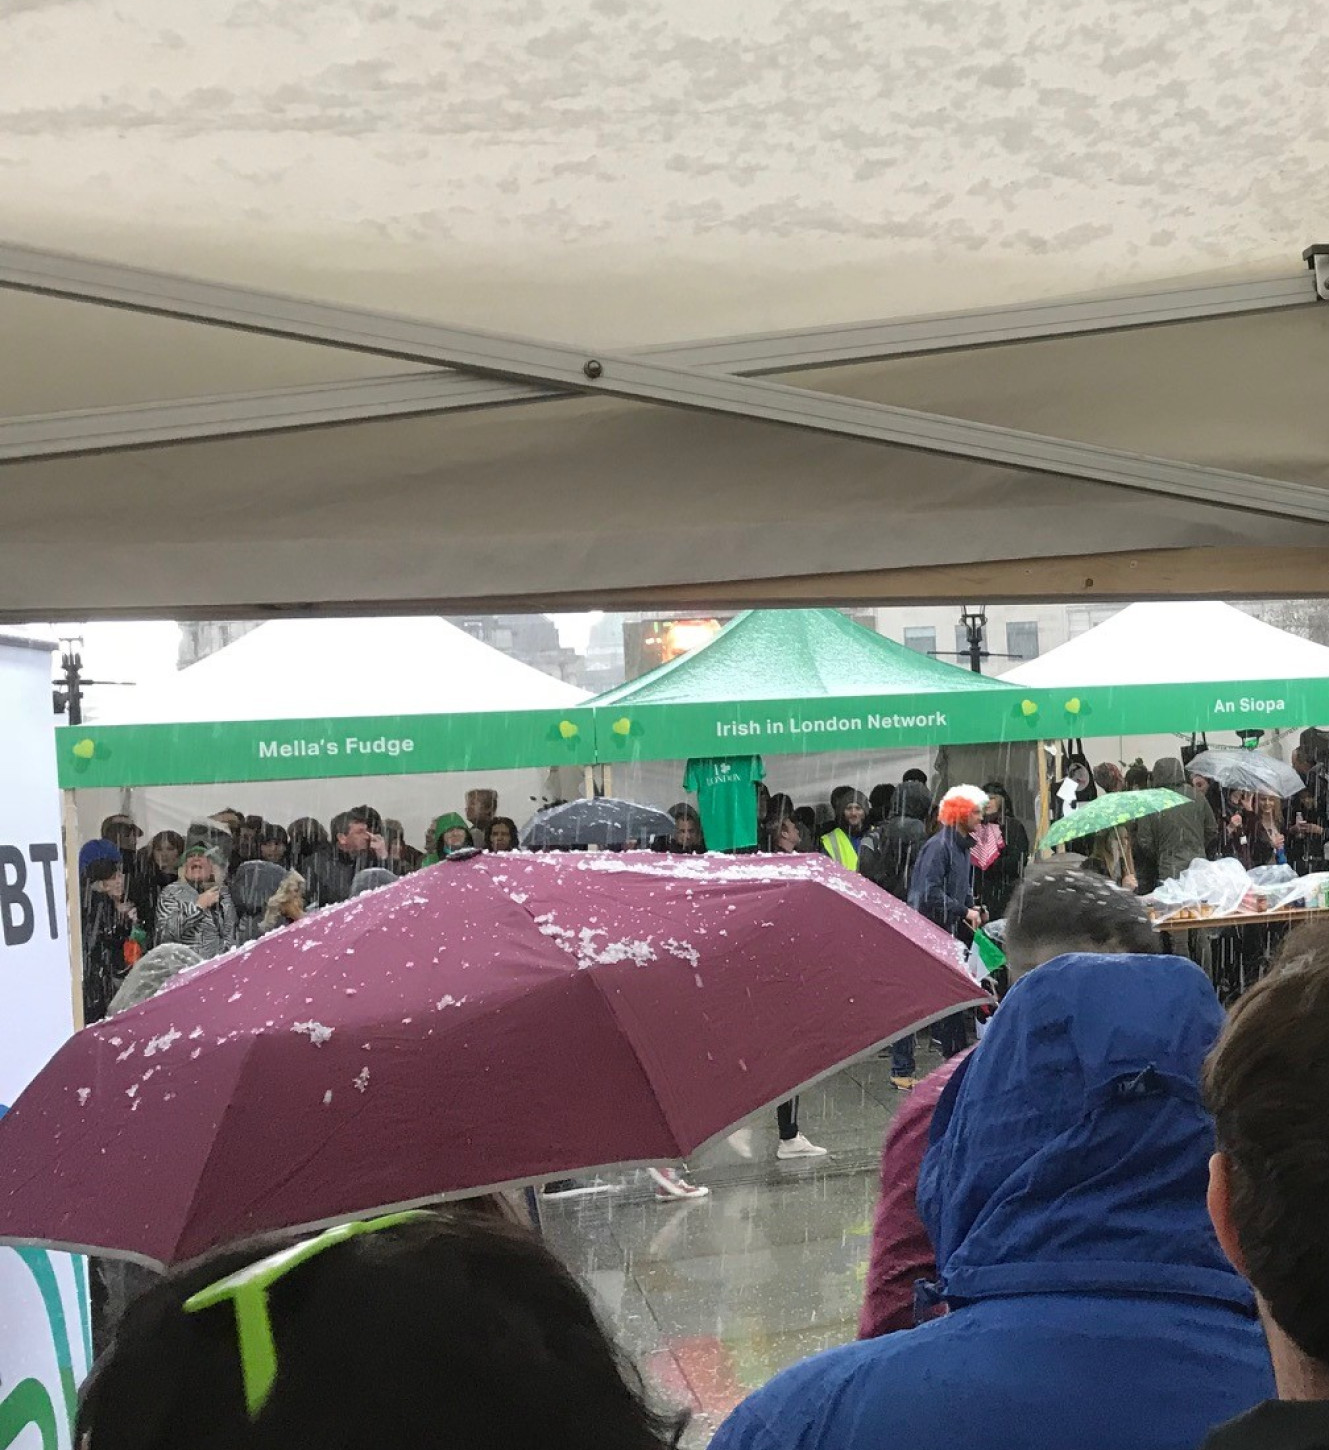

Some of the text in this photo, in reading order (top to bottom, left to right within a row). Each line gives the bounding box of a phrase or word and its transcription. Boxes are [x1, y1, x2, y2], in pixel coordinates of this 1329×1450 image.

[1214, 697, 1285, 714] An Siopa
[716, 711, 947, 737] Irish in London Network
[259, 736, 415, 758] Mella's Fudge
